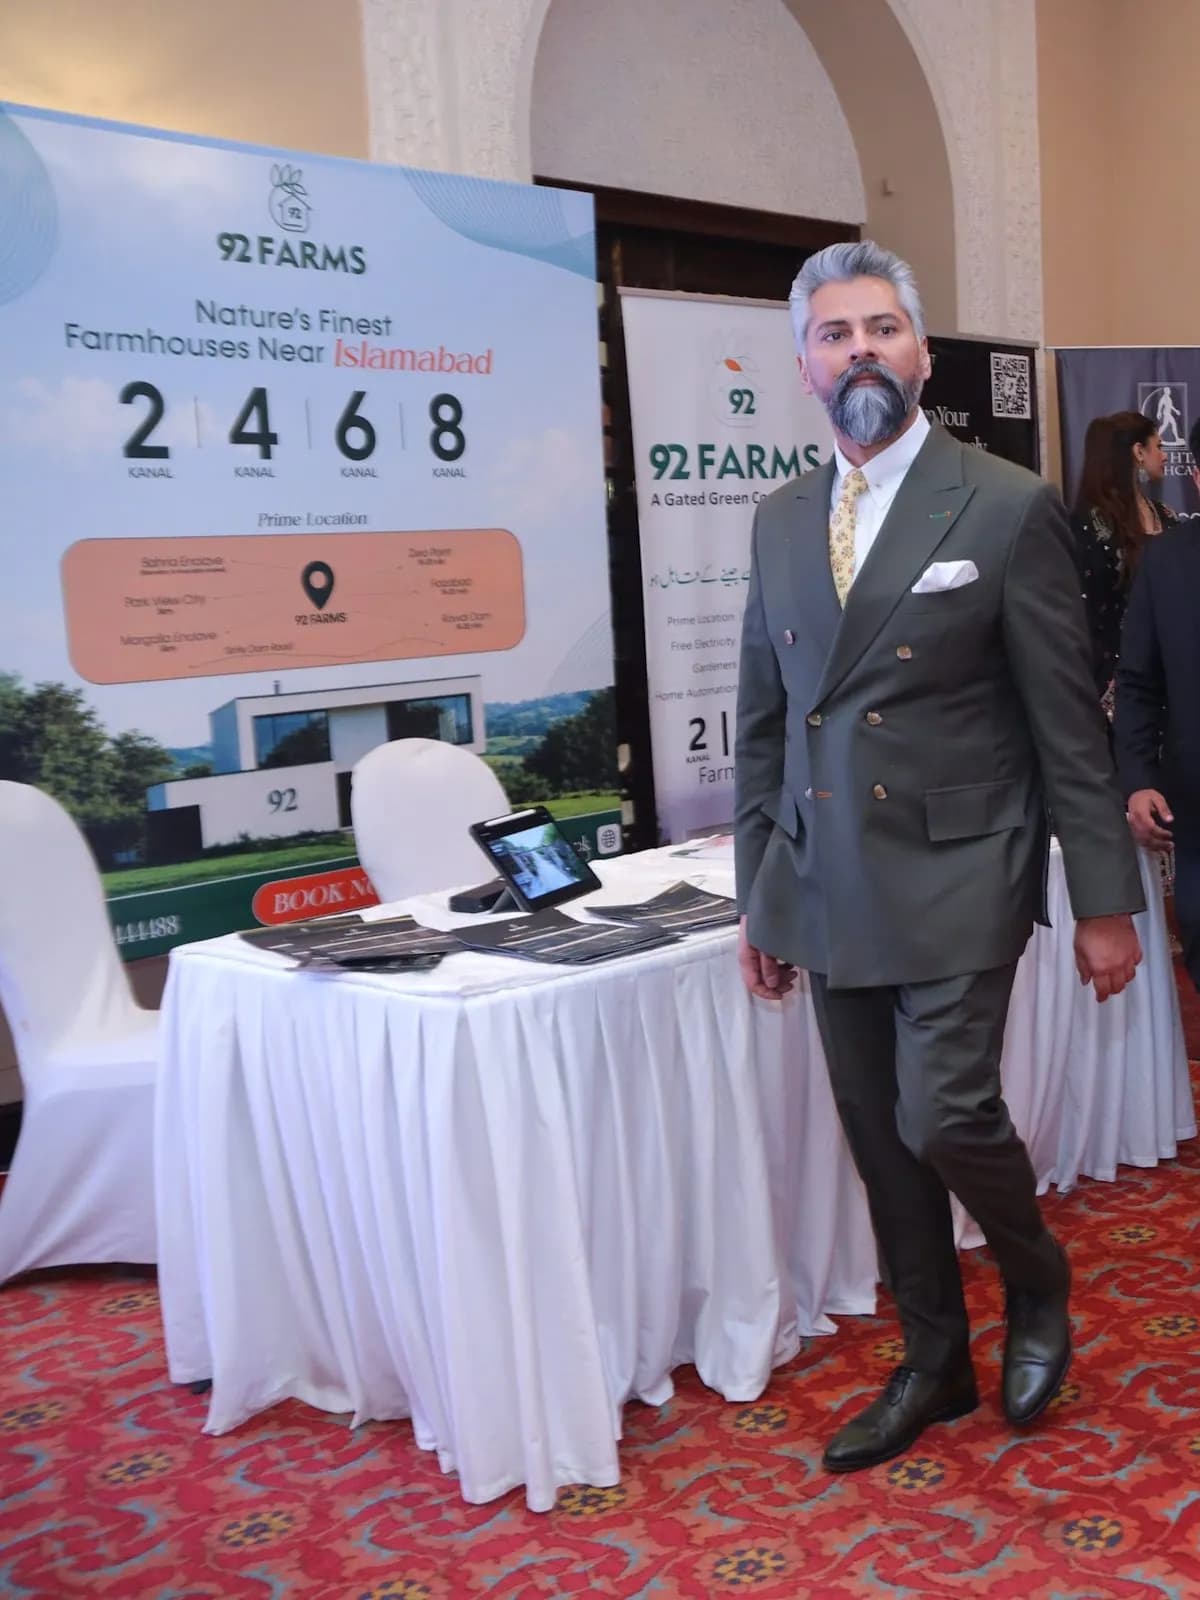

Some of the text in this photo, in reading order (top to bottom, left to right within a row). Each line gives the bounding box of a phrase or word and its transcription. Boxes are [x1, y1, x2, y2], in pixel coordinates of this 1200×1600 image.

[217, 232, 367, 275] 92 FARMS
[194, 300, 393, 337] Nature's Finest
[65, 323, 494, 375] Farmhouses Near Islamabad
[729, 389, 755, 415] 92
[118, 381, 466, 462] 2 4 6 8
[935, 405, 970, 427] Your
[128, 465, 467, 479] KANAL KANAL KANAL KANAL
[649, 443, 821, 480] 92 FARMS
[650, 493, 660, 506] A
[664, 492, 705, 506] Gated
[708, 492, 749, 505] Green
[258, 510, 368, 528] Prime Location
[295, 610, 347, 626] 92 FARMS
[667, 613, 735, 626] Prime Location
[670, 637, 736, 652] Free Electricity
[689, 717, 707, 751] 2
[699, 765, 736, 784] Farm
[267, 788, 298, 814] 92
[272, 882, 346, 915] BOOK
